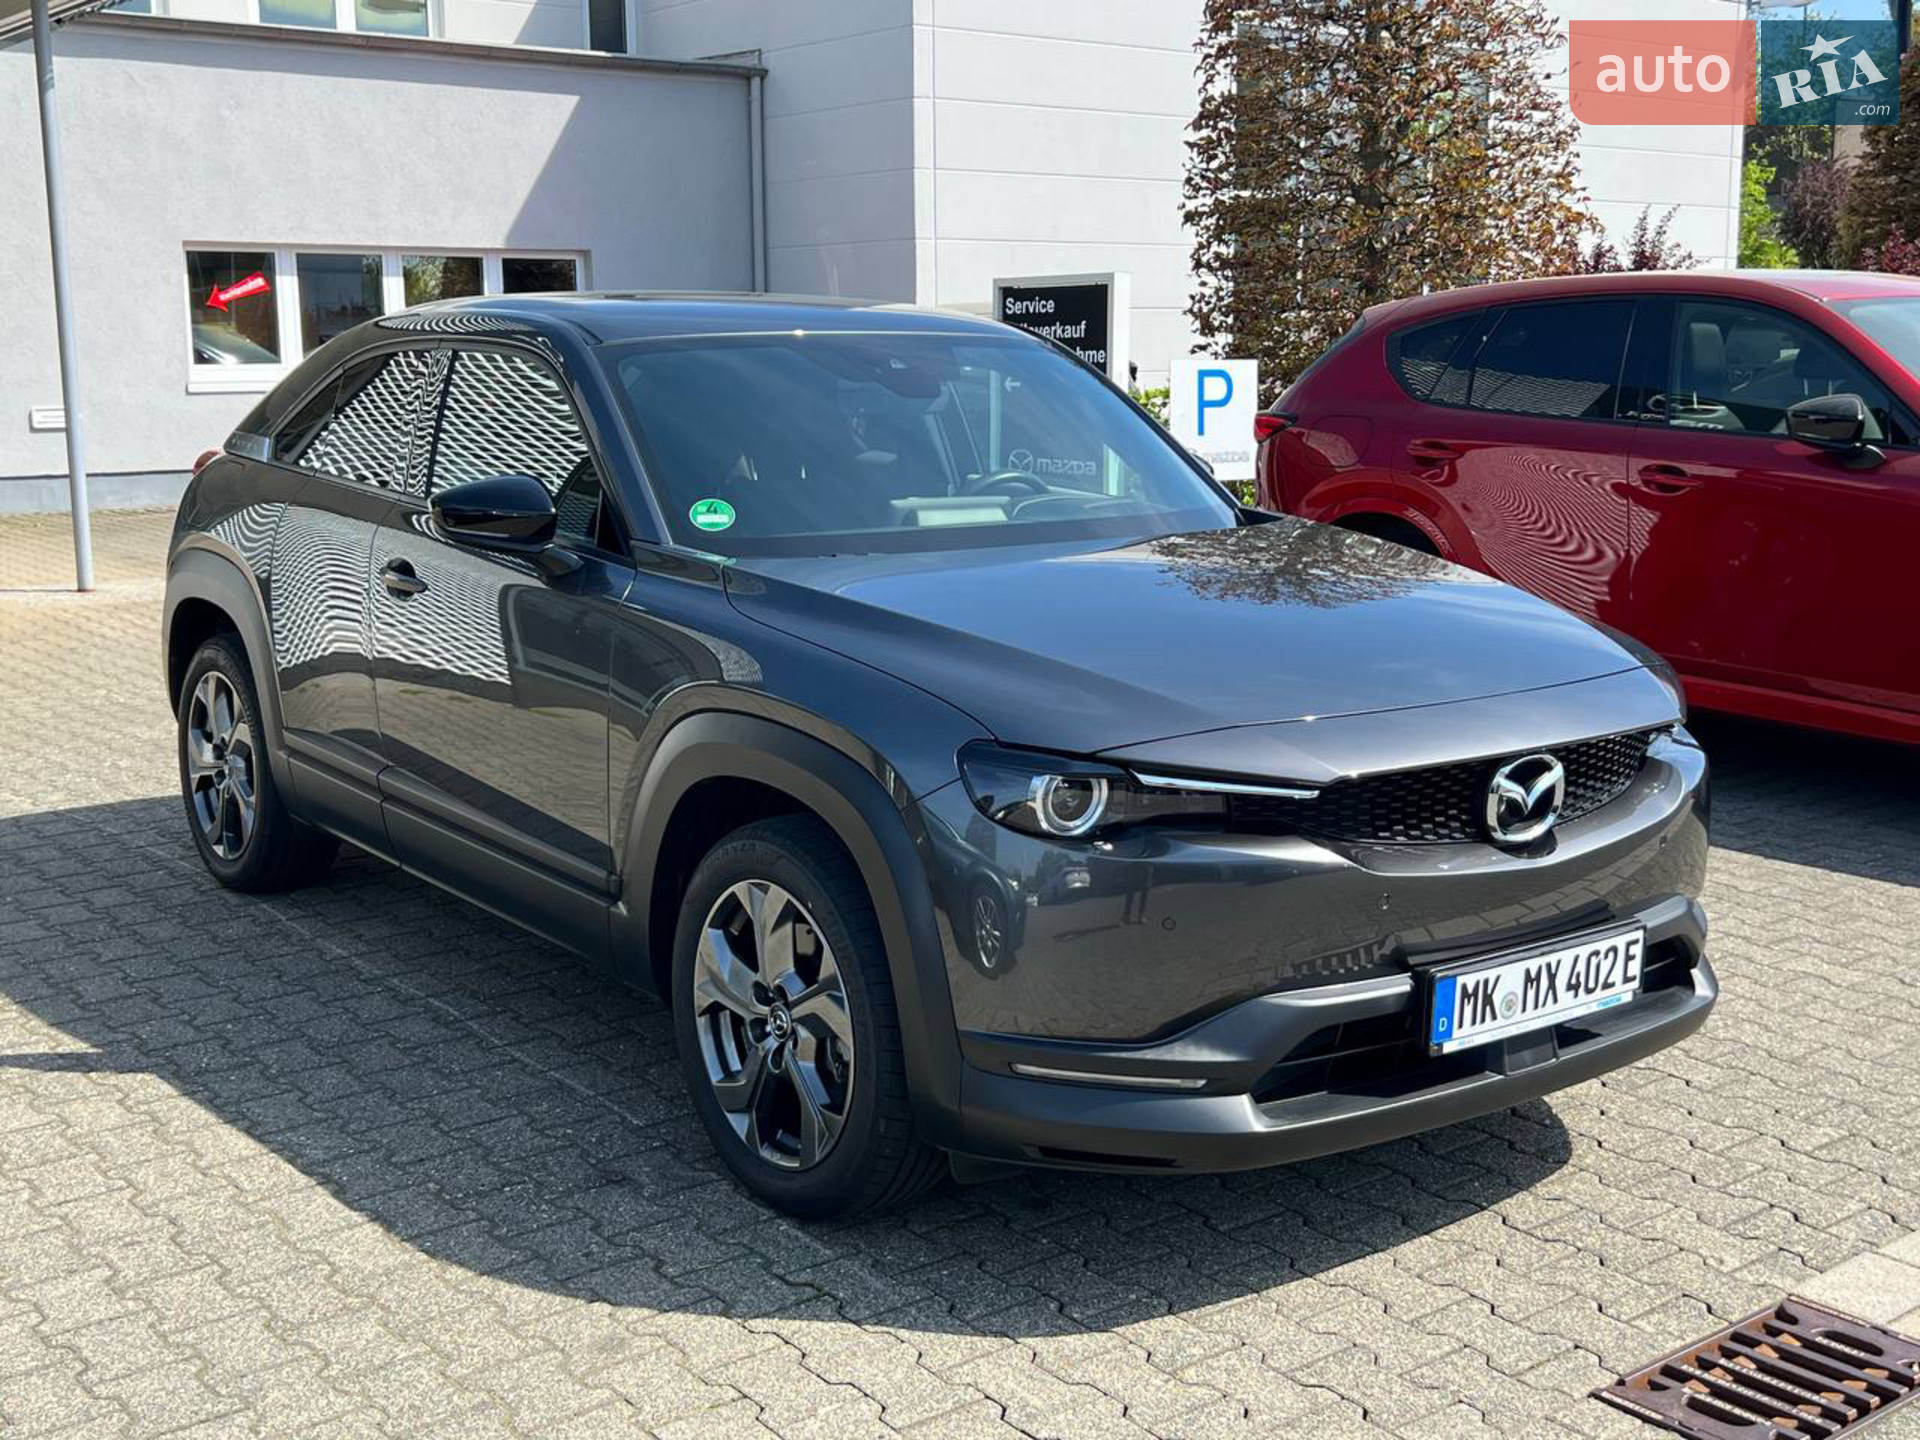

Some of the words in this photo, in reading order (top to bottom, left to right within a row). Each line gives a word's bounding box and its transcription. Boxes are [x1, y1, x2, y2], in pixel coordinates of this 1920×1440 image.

[1005, 296, 1055, 314] Service
[1196, 369, 1234, 436] P
[706, 501, 718, 515] 4
[1457, 974, 1501, 1030] MK
[1521, 958, 1563, 1014] MX
[1565, 938, 1640, 999] 402E
[1438, 1017, 1448, 1032] D
